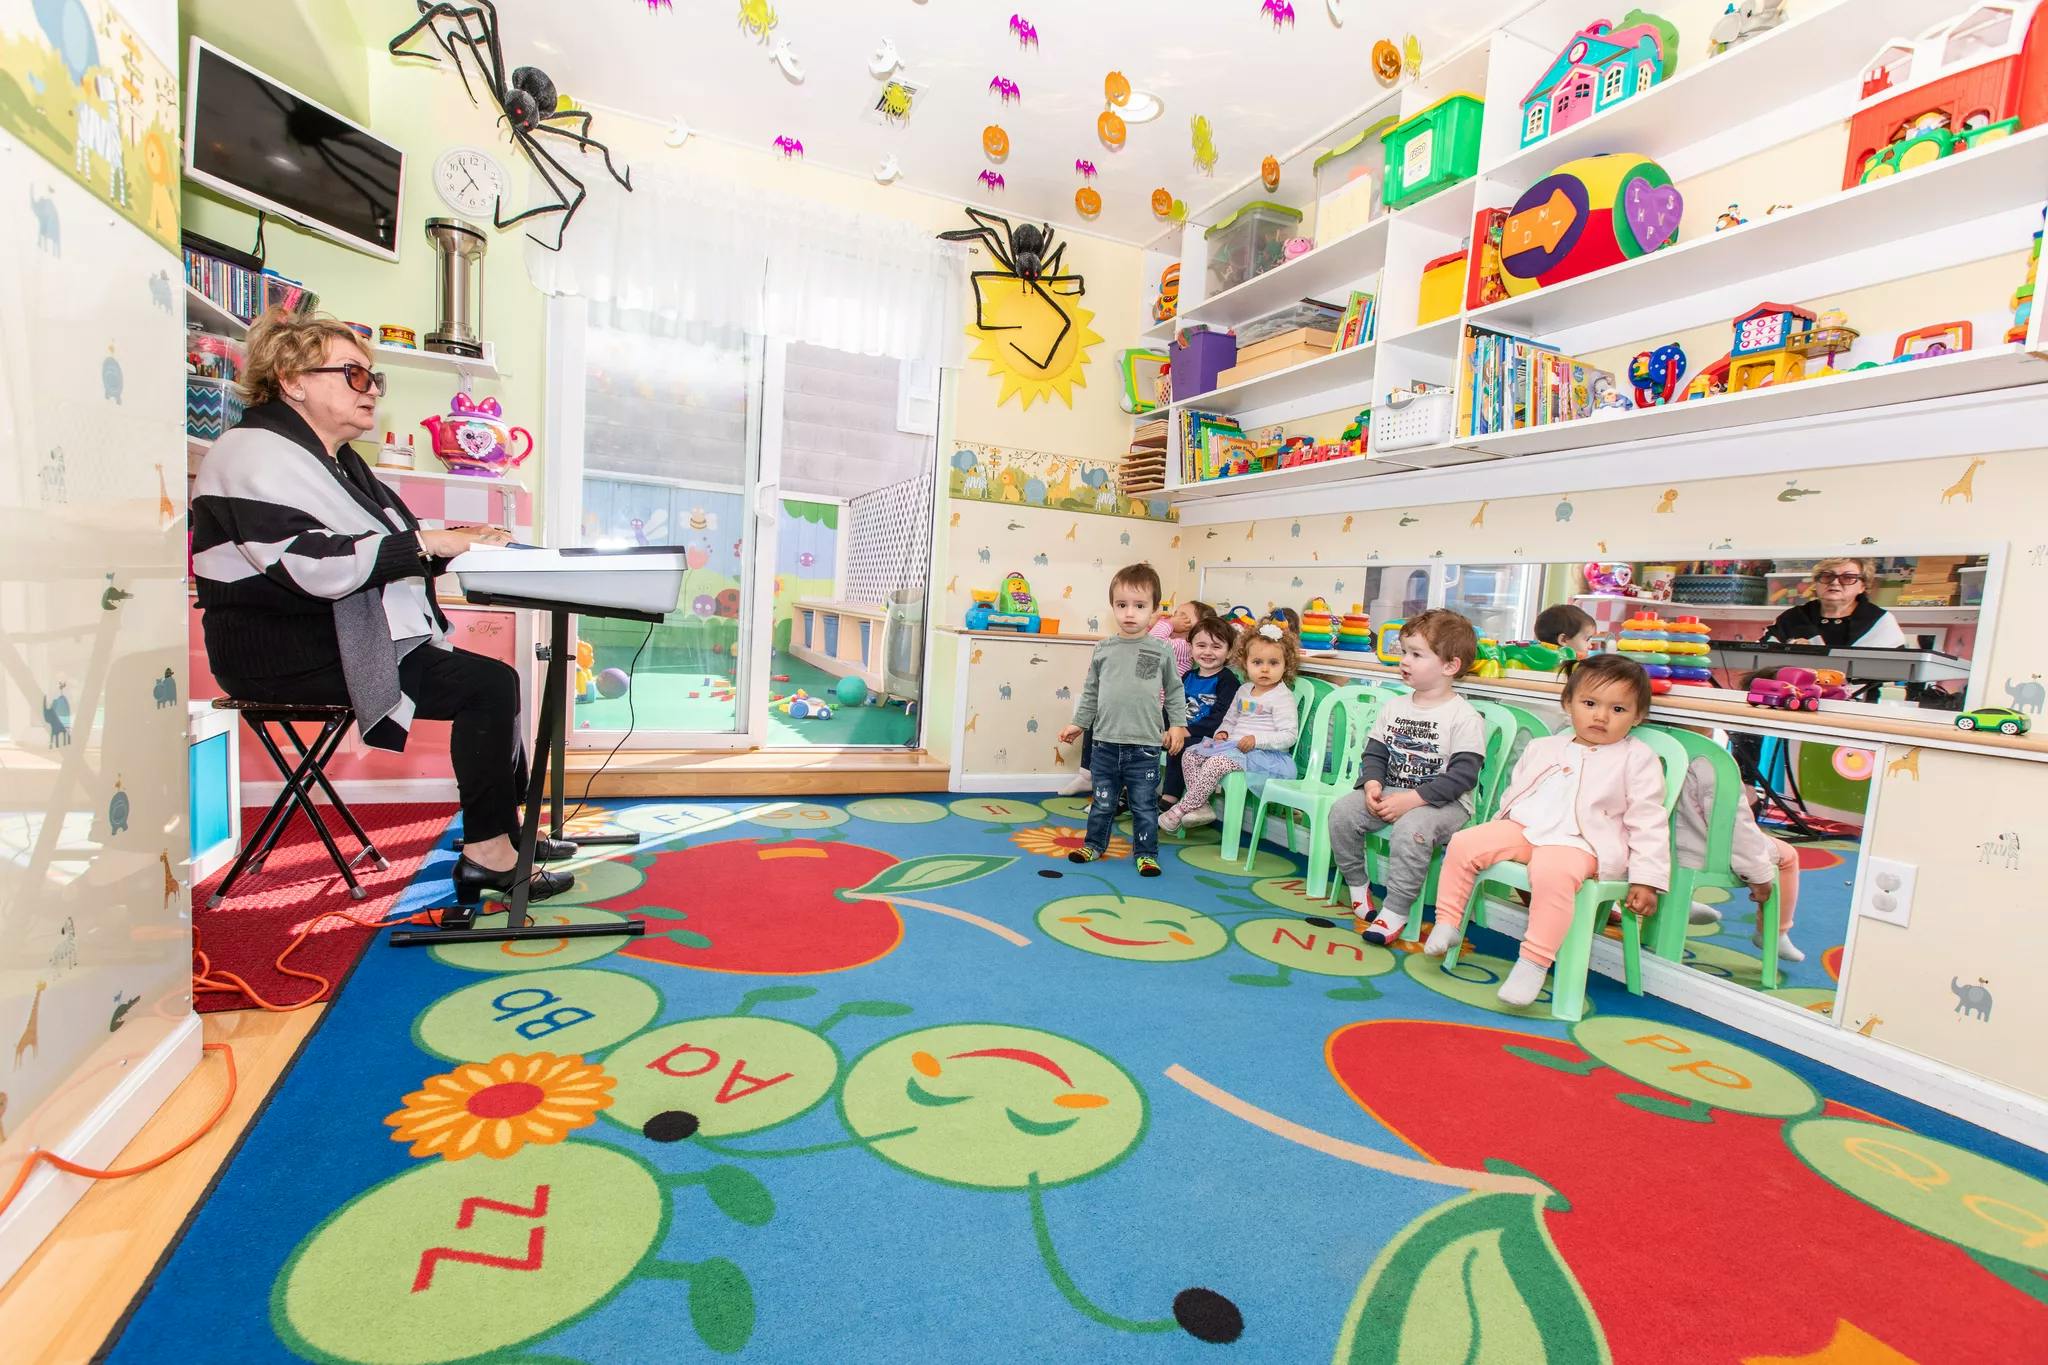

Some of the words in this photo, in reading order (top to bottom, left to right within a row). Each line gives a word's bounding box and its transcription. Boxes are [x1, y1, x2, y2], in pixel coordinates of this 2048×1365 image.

[449, 162, 459, 171] 10
[469, 156, 479, 166] 12
[1271, 926, 1364, 962] Nn
[491, 988, 597, 1041] Bb
[645, 1042, 796, 1105] Aa
[1622, 1033, 1753, 1090] Pp
[410, 1183, 551, 1294] Zz
